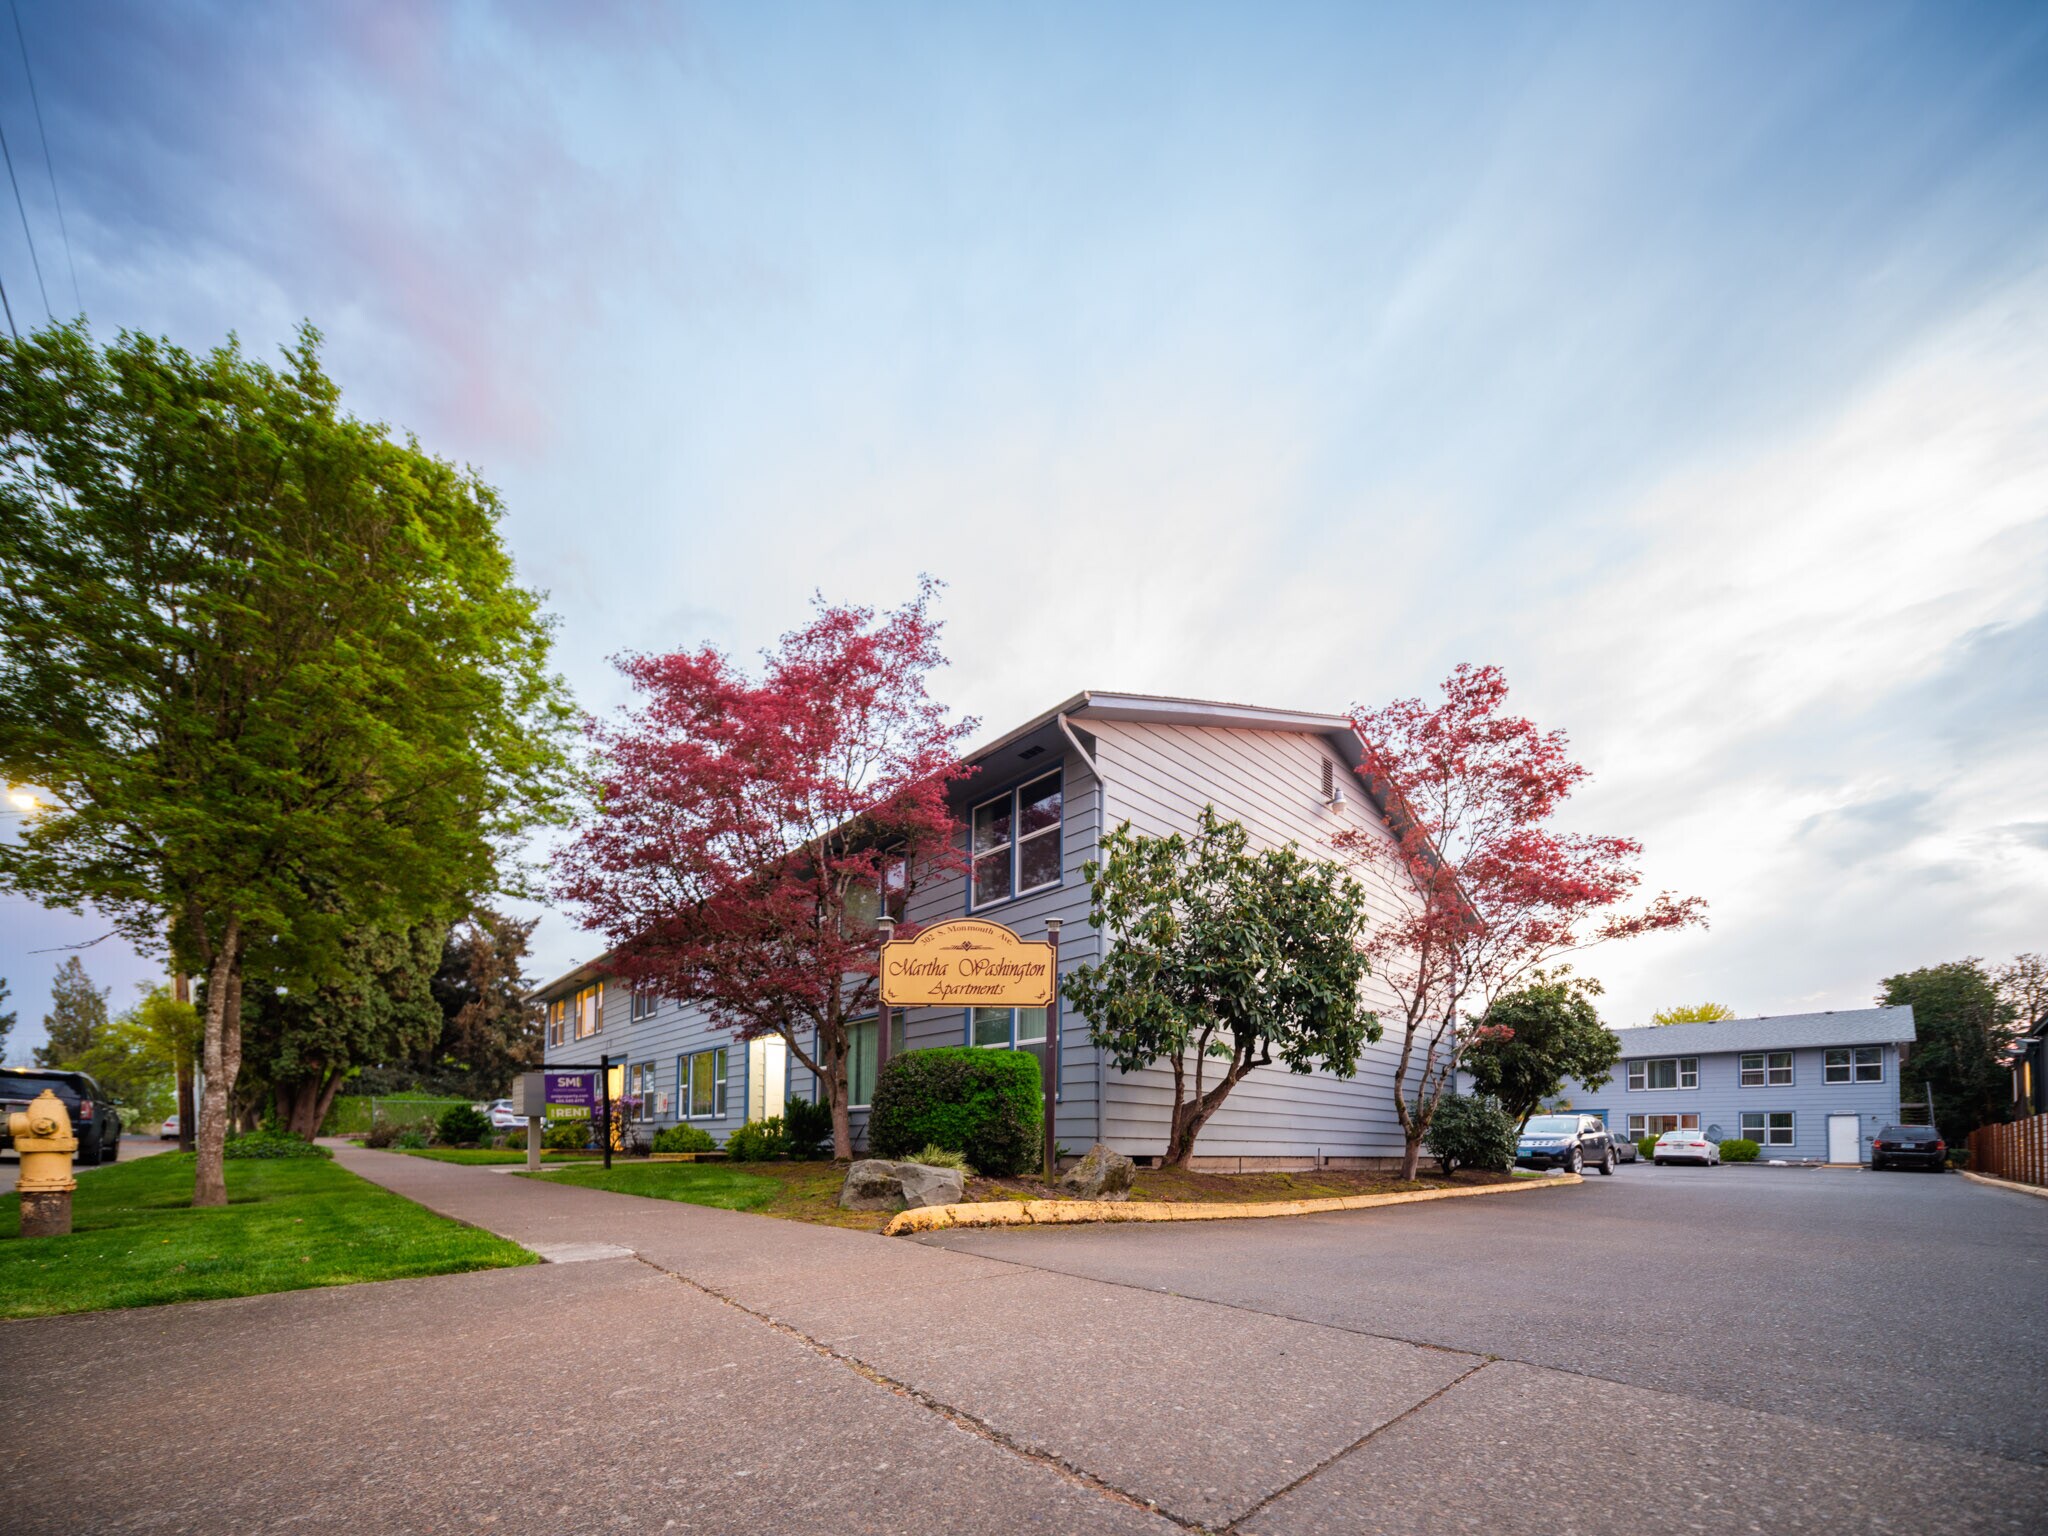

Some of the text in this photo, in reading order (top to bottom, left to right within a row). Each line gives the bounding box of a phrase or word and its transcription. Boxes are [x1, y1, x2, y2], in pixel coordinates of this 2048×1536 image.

[921, 934, 935, 945] 302
[947, 925, 994, 935] Monmouth
[998, 933, 1013, 946] Ave.
[889, 955, 1046, 984] Martha Washington
[928, 981, 1005, 1000] Apartments
[556, 1107, 589, 1117] RENT
